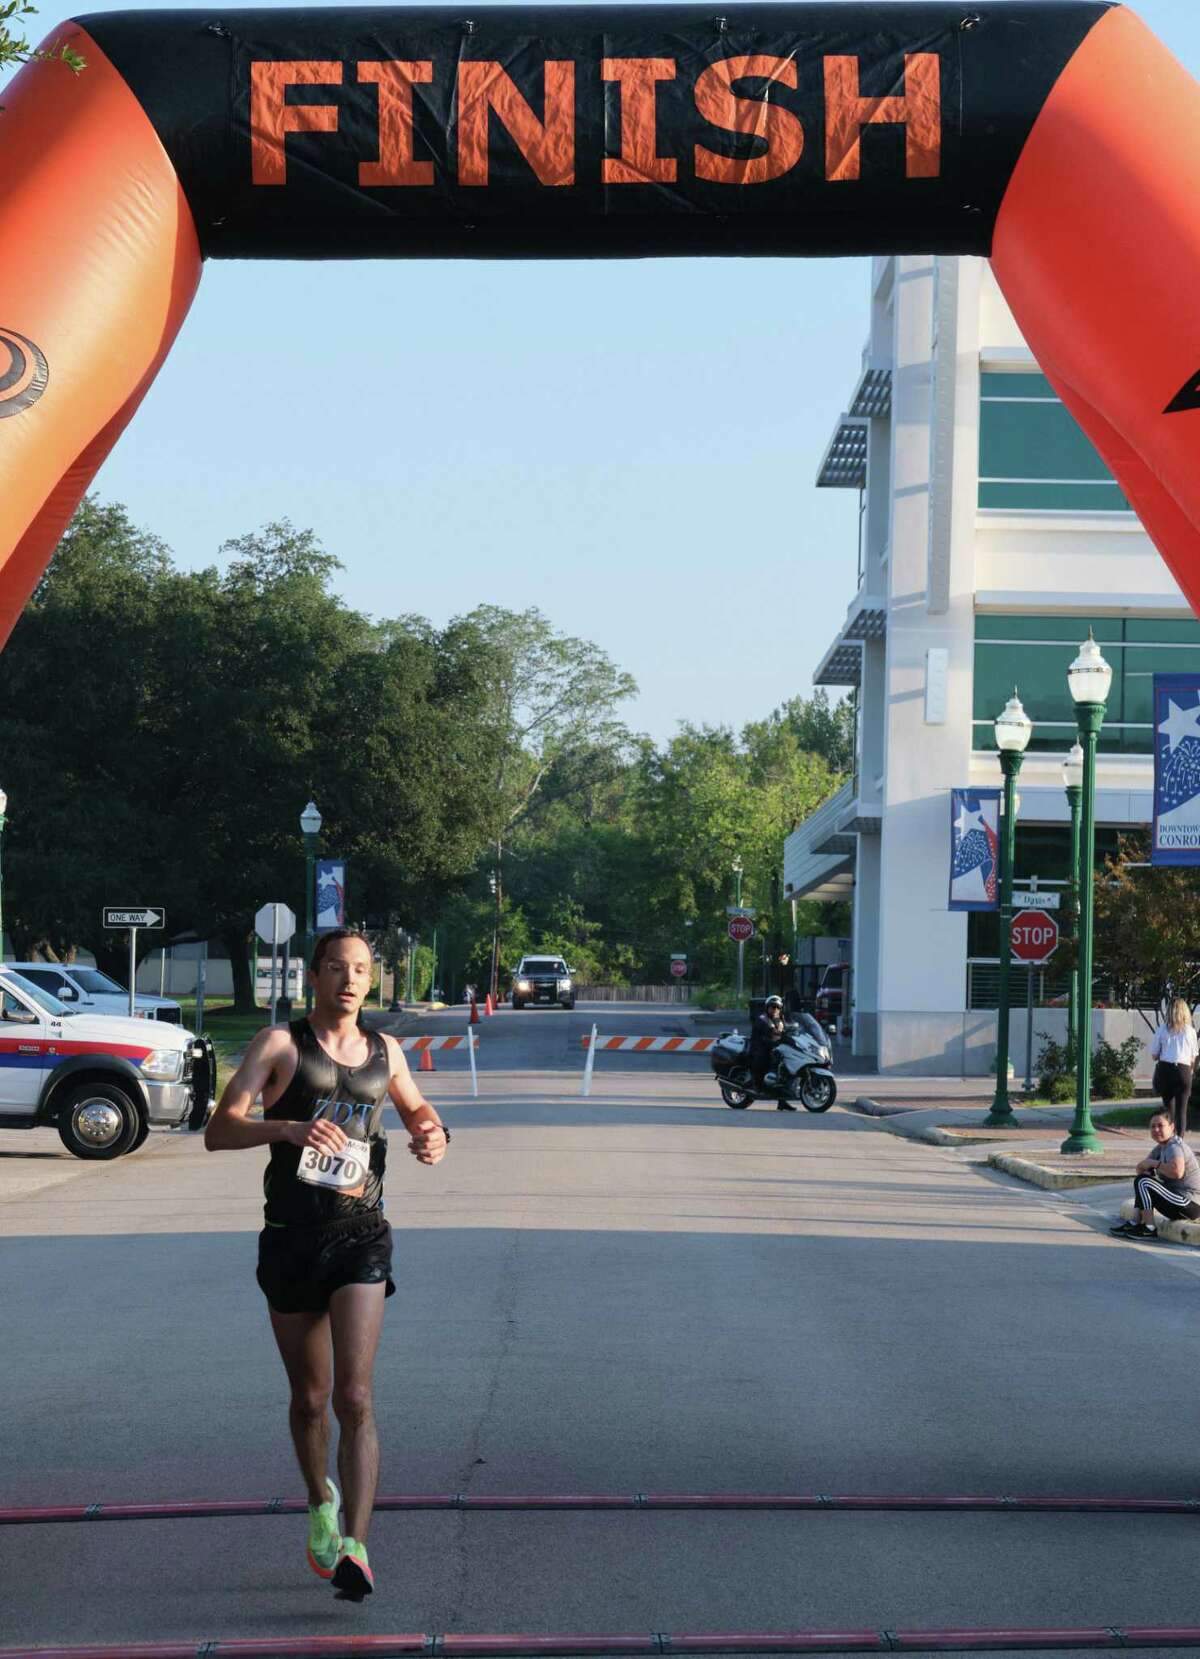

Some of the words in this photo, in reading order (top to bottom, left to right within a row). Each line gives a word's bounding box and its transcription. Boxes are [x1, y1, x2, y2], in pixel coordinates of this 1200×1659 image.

[250, 52, 942, 187] FINISH
[1160, 824, 1200, 833] DOWNTOW
[1160, 834, 1200, 846] CONRO
[110, 913, 127, 921] ONE
[128, 913, 145, 921] WAY
[731, 923, 751, 933] STOP
[1011, 927, 1054, 945] STOP
[304, 1150, 357, 1180] 3070
